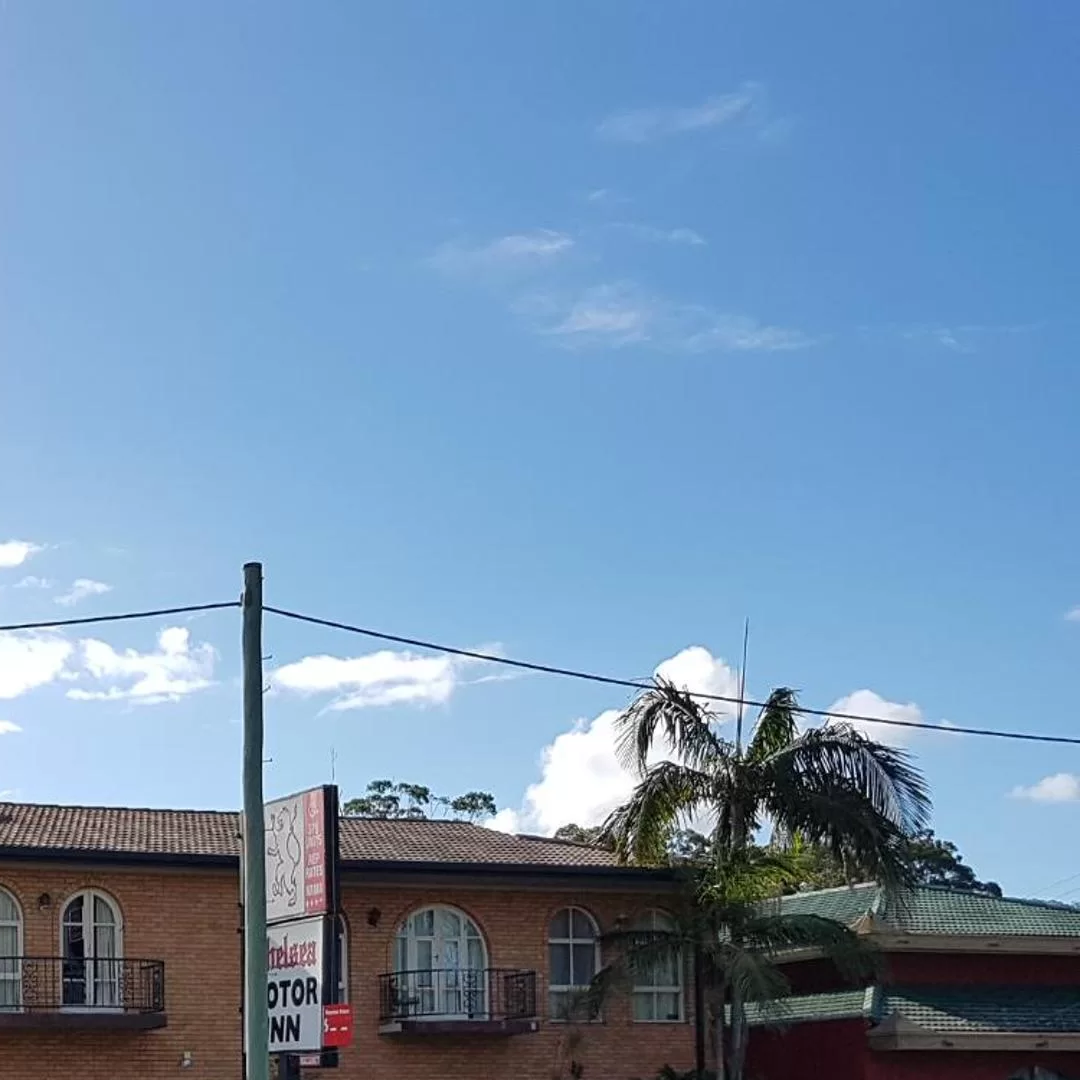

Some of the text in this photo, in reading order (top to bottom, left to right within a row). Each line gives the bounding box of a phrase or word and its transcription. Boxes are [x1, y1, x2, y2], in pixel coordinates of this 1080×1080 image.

[267, 932, 316, 970] helsea
[267, 976, 318, 1009] OTOR
[267, 1013, 301, 1043] NN
